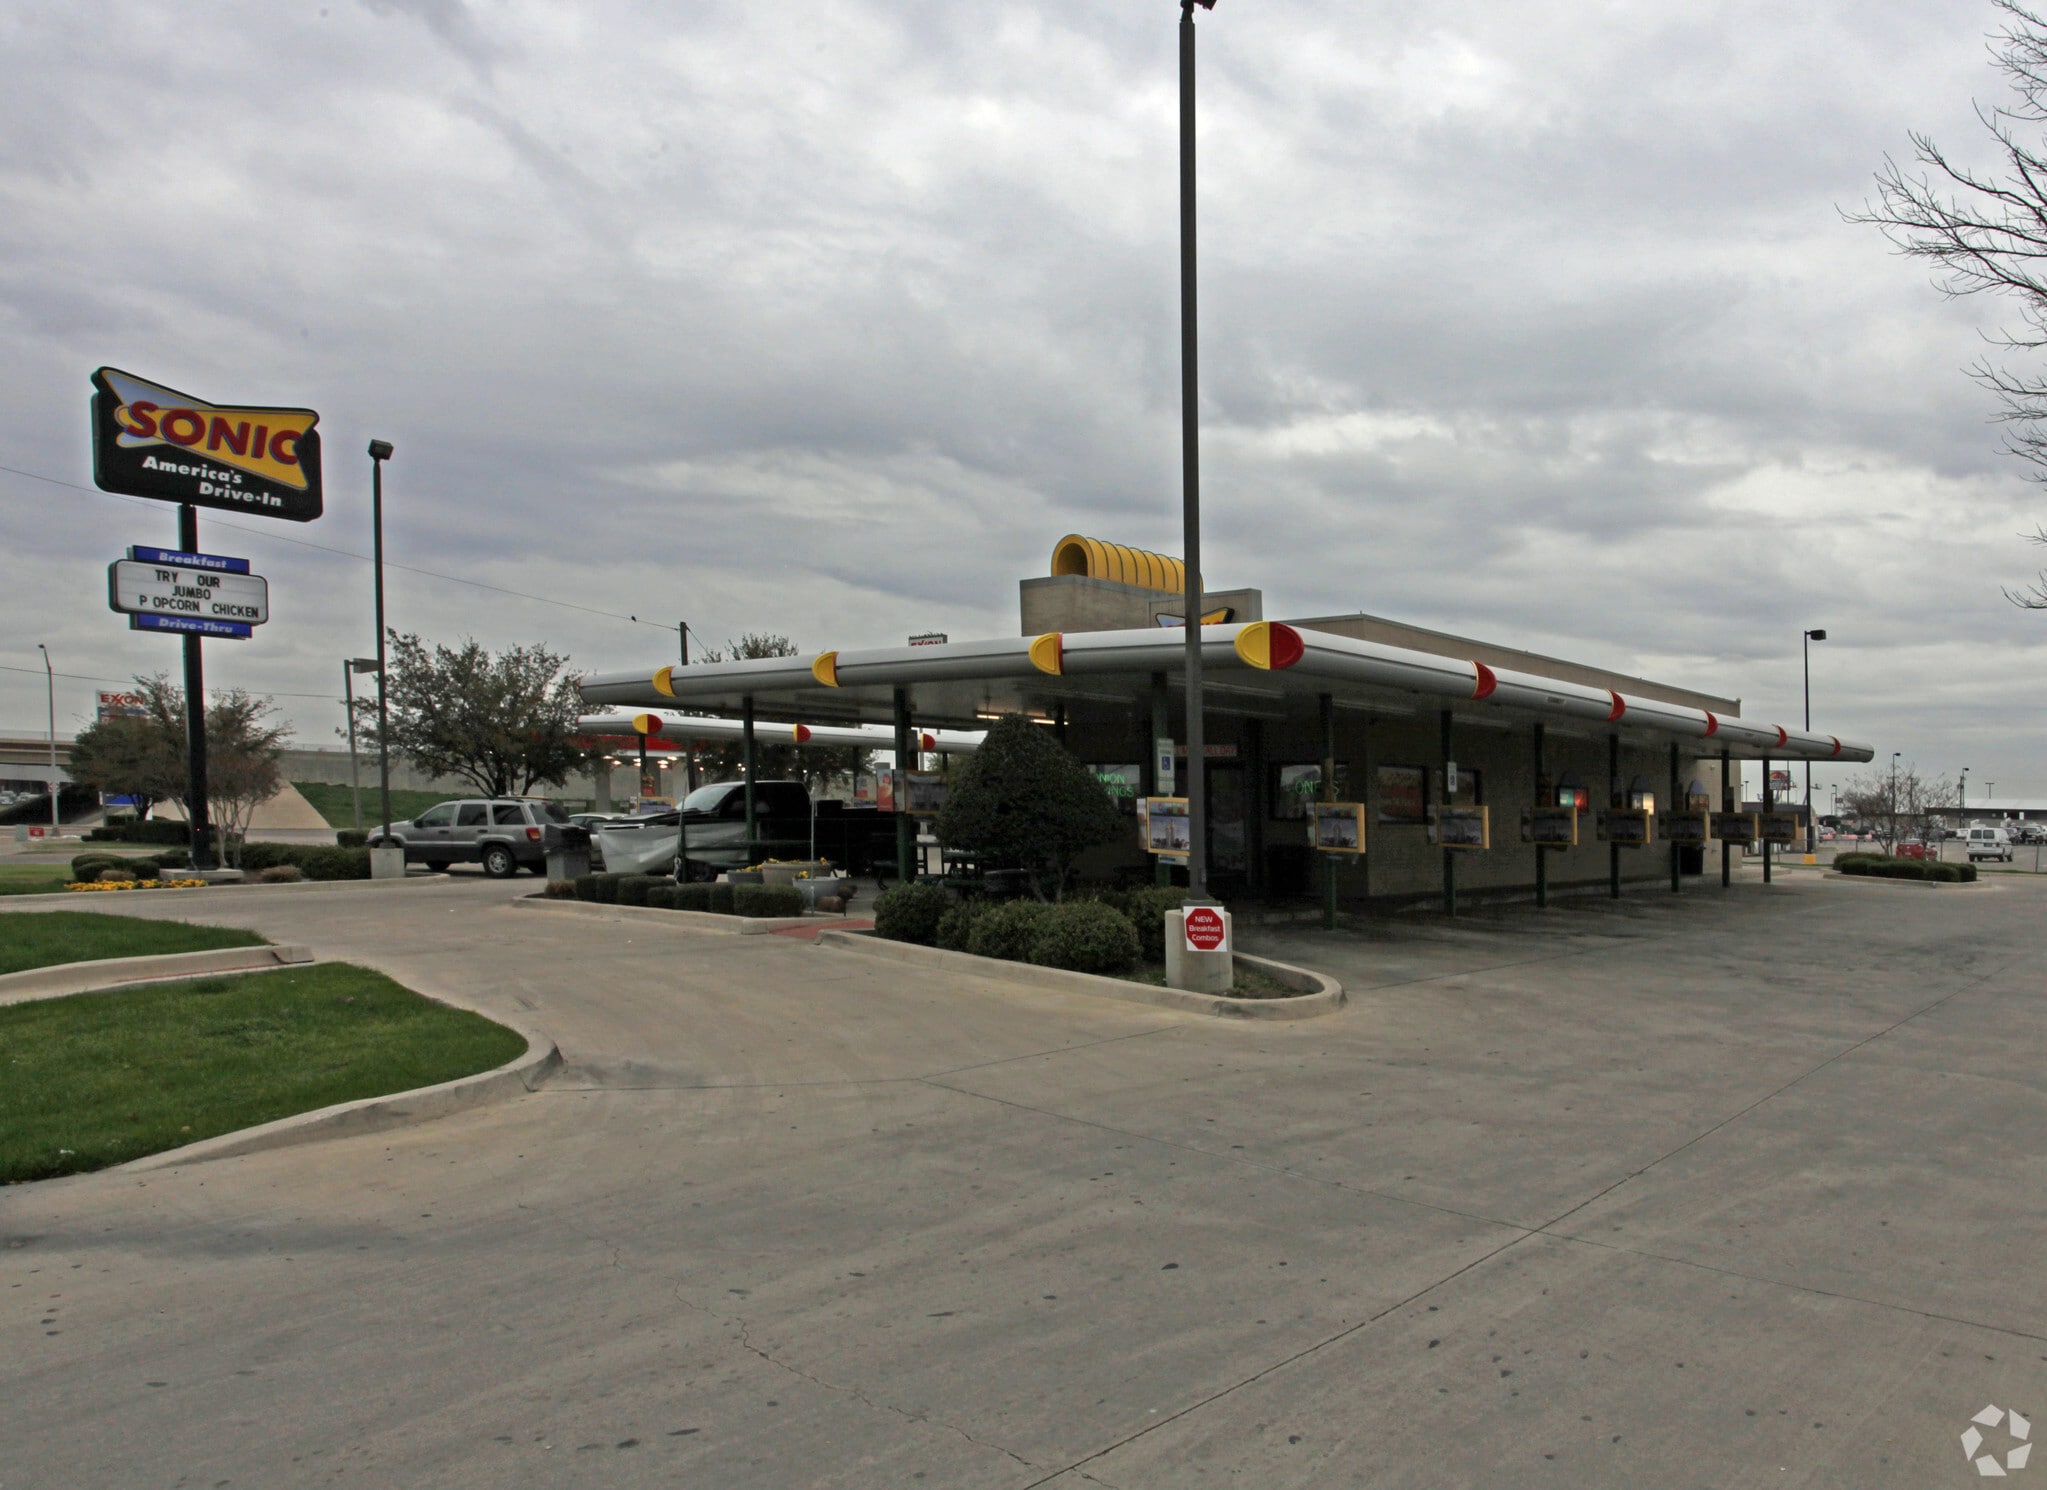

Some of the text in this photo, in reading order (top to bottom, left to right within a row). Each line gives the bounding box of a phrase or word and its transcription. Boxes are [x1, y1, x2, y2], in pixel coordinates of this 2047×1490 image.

[123, 400, 303, 465] SONIC
[142, 456, 242, 484] America's
[199, 482, 282, 507] Drive-In
[158, 552, 228, 569] Breakfast
[155, 569, 220, 588] TRY OUR
[172, 585, 211, 600] JUMBO
[212, 603, 259, 618] CHICKEN
[158, 618, 233, 633] Drive-Thru
